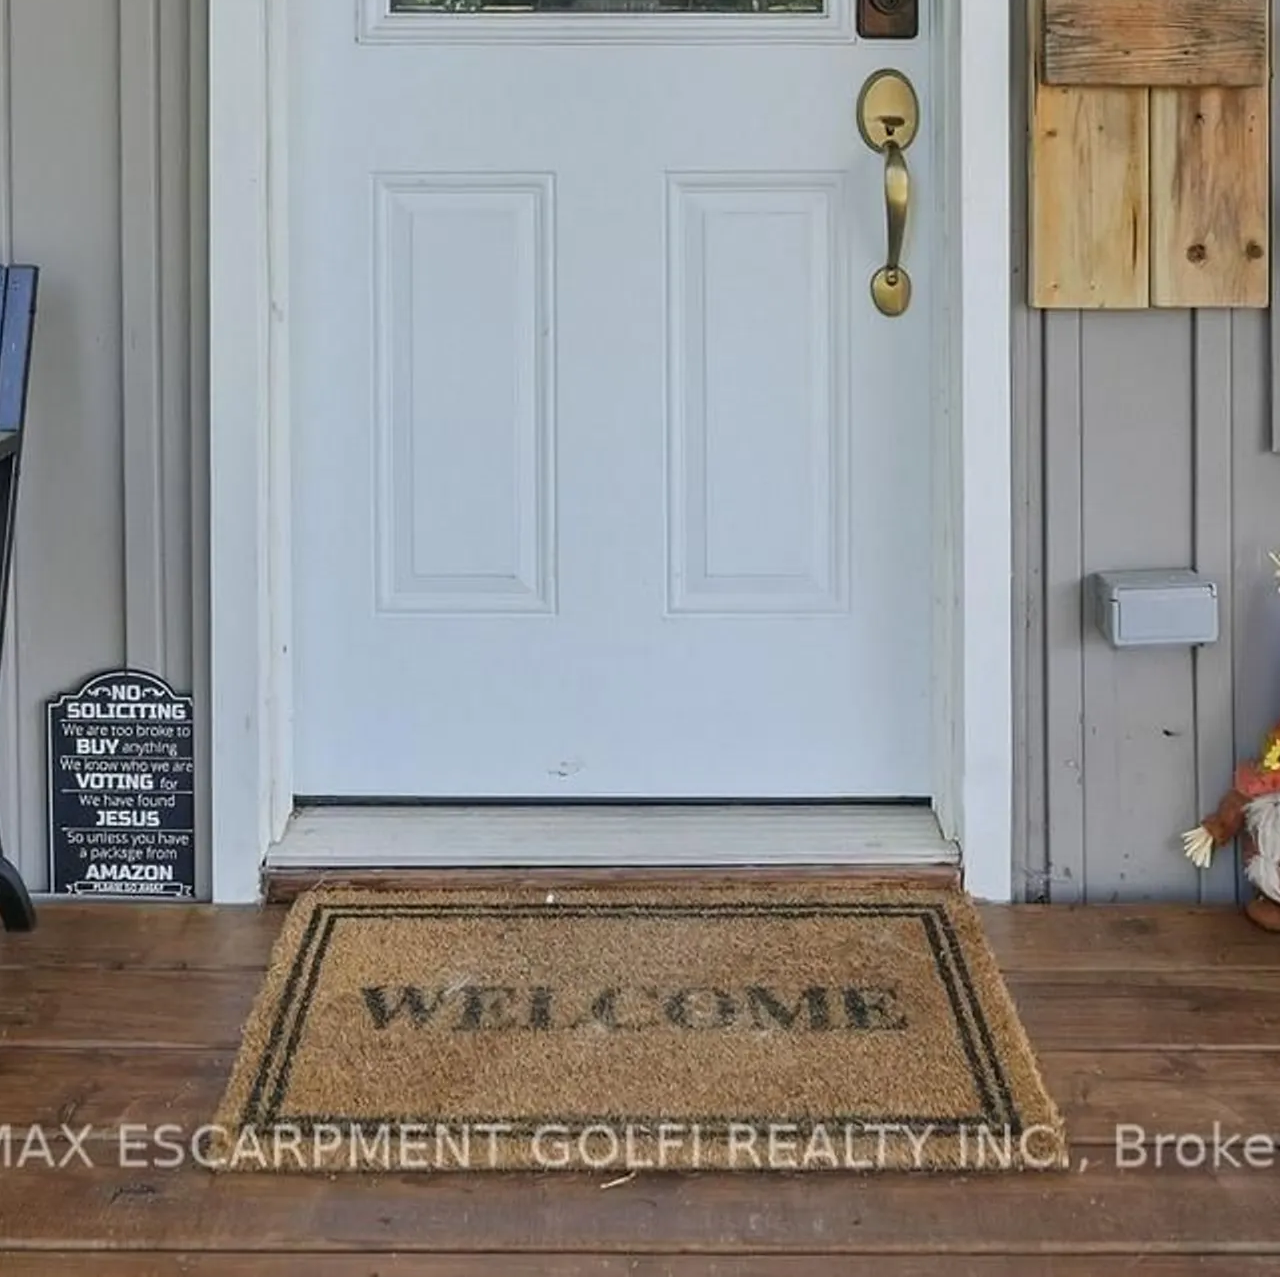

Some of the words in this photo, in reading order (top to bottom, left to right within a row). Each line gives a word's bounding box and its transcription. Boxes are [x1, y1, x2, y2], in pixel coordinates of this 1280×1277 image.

[111, 685, 141, 701] NO
[67, 703, 186, 720] SOLICITING
[62, 723, 83, 736] We
[86, 725, 109, 736] are
[111, 725, 133, 737] too
[136, 724, 174, 738] broke
[177, 726, 192, 737] to
[76, 738, 119, 754] BUY
[122, 741, 178, 757] anything
[60, 757, 81, 771] We
[84, 757, 118, 771] know
[120, 759, 148, 772] who
[150, 761, 169, 772] we
[172, 762, 193, 772] are
[75, 773, 154, 790] VOTING
[160, 776, 178, 790] for
[79, 794, 100, 807] We
[103, 794, 134, 807] have
[136, 794, 176, 808] found
[95, 810, 160, 826] JESUS
[66, 831, 84, 844] So
[86, 831, 129, 844] unless
[131, 833, 155, 846] you
[158, 831, 190, 846] have
[80, 848, 88, 859] a
[90, 847, 143, 863] package
[145, 846, 178, 860] from
[85, 864, 173, 880] AMAZON
[360, 984, 910, 1031] WELCOME
